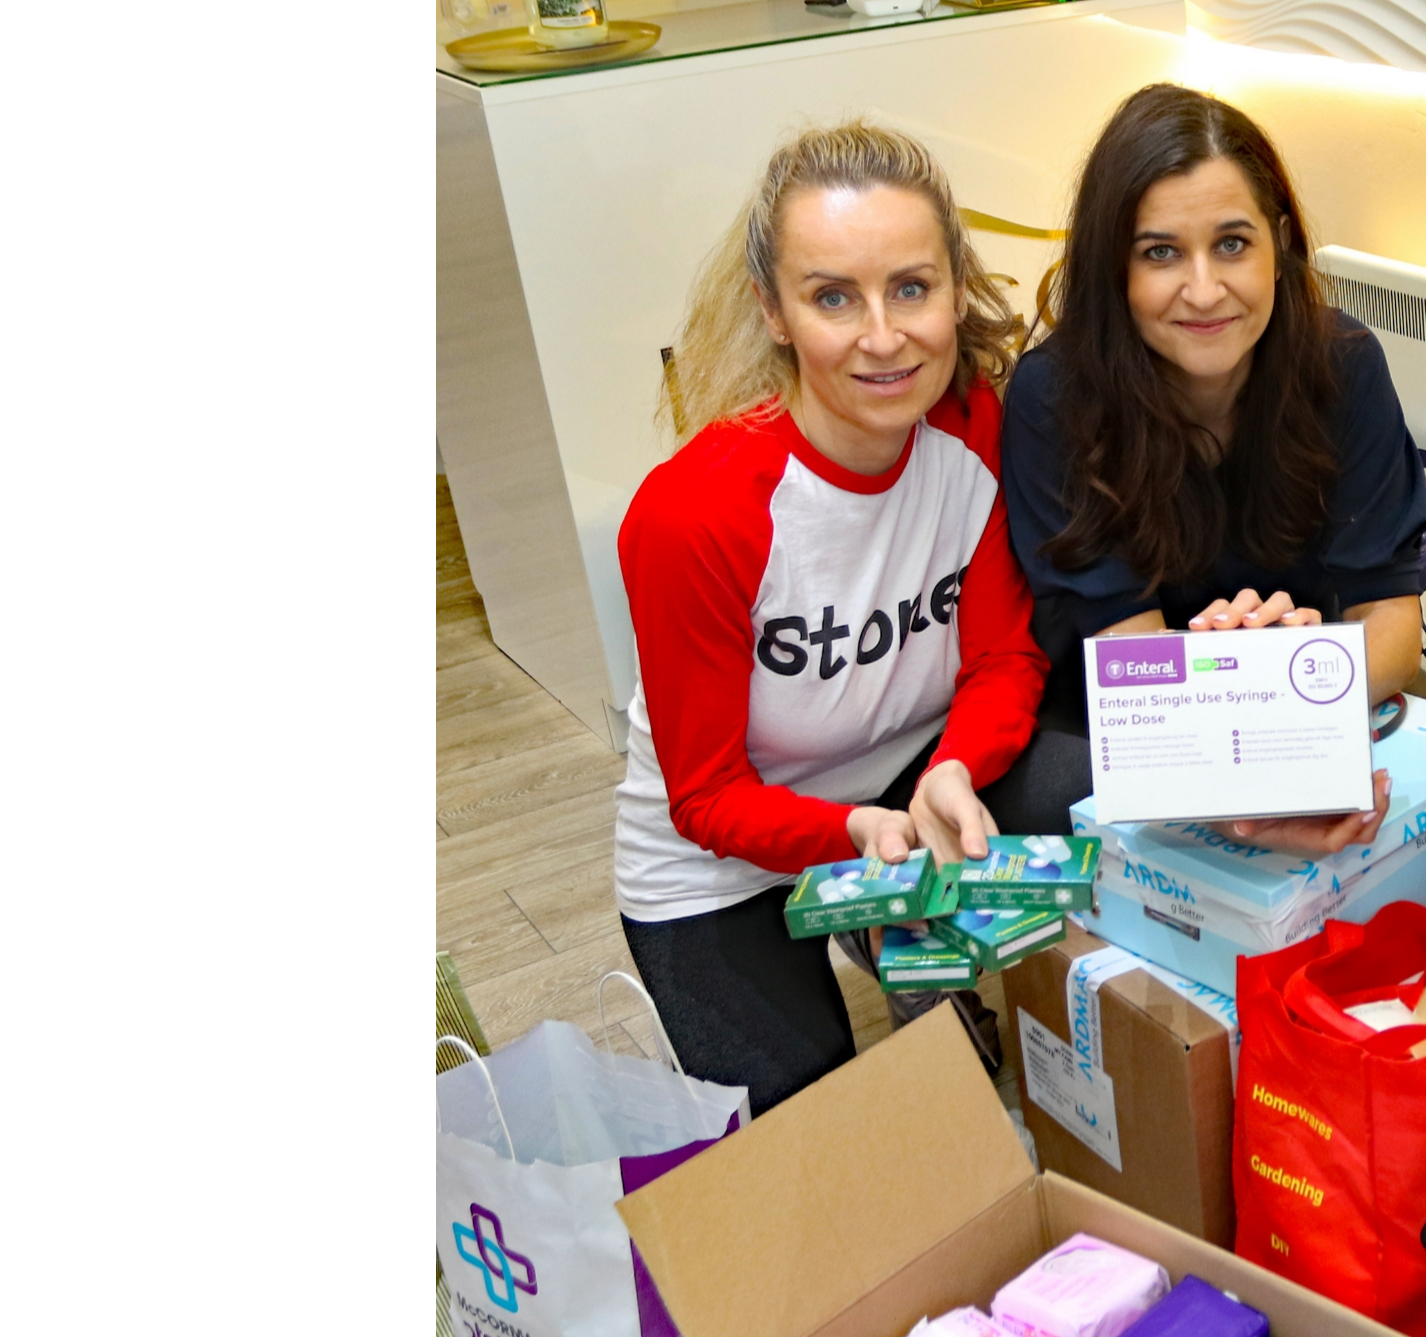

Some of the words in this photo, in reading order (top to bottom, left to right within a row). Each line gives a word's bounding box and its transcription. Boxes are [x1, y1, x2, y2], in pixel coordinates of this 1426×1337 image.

[1099, 696, 1147, 709] Enteral
[1150, 694, 1193, 708] Single
[1196, 692, 1223, 704] Use
[1226, 689, 1278, 704] Syringe
[1099, 716, 1128, 727] Low
[1131, 713, 1166, 726] Dose
[1178, 904, 1205, 922] Better
[1252, 1084, 1333, 1141] Homewares
[1251, 1155, 1325, 1207] Gardening
[1271, 1233, 1290, 1257] DIY
